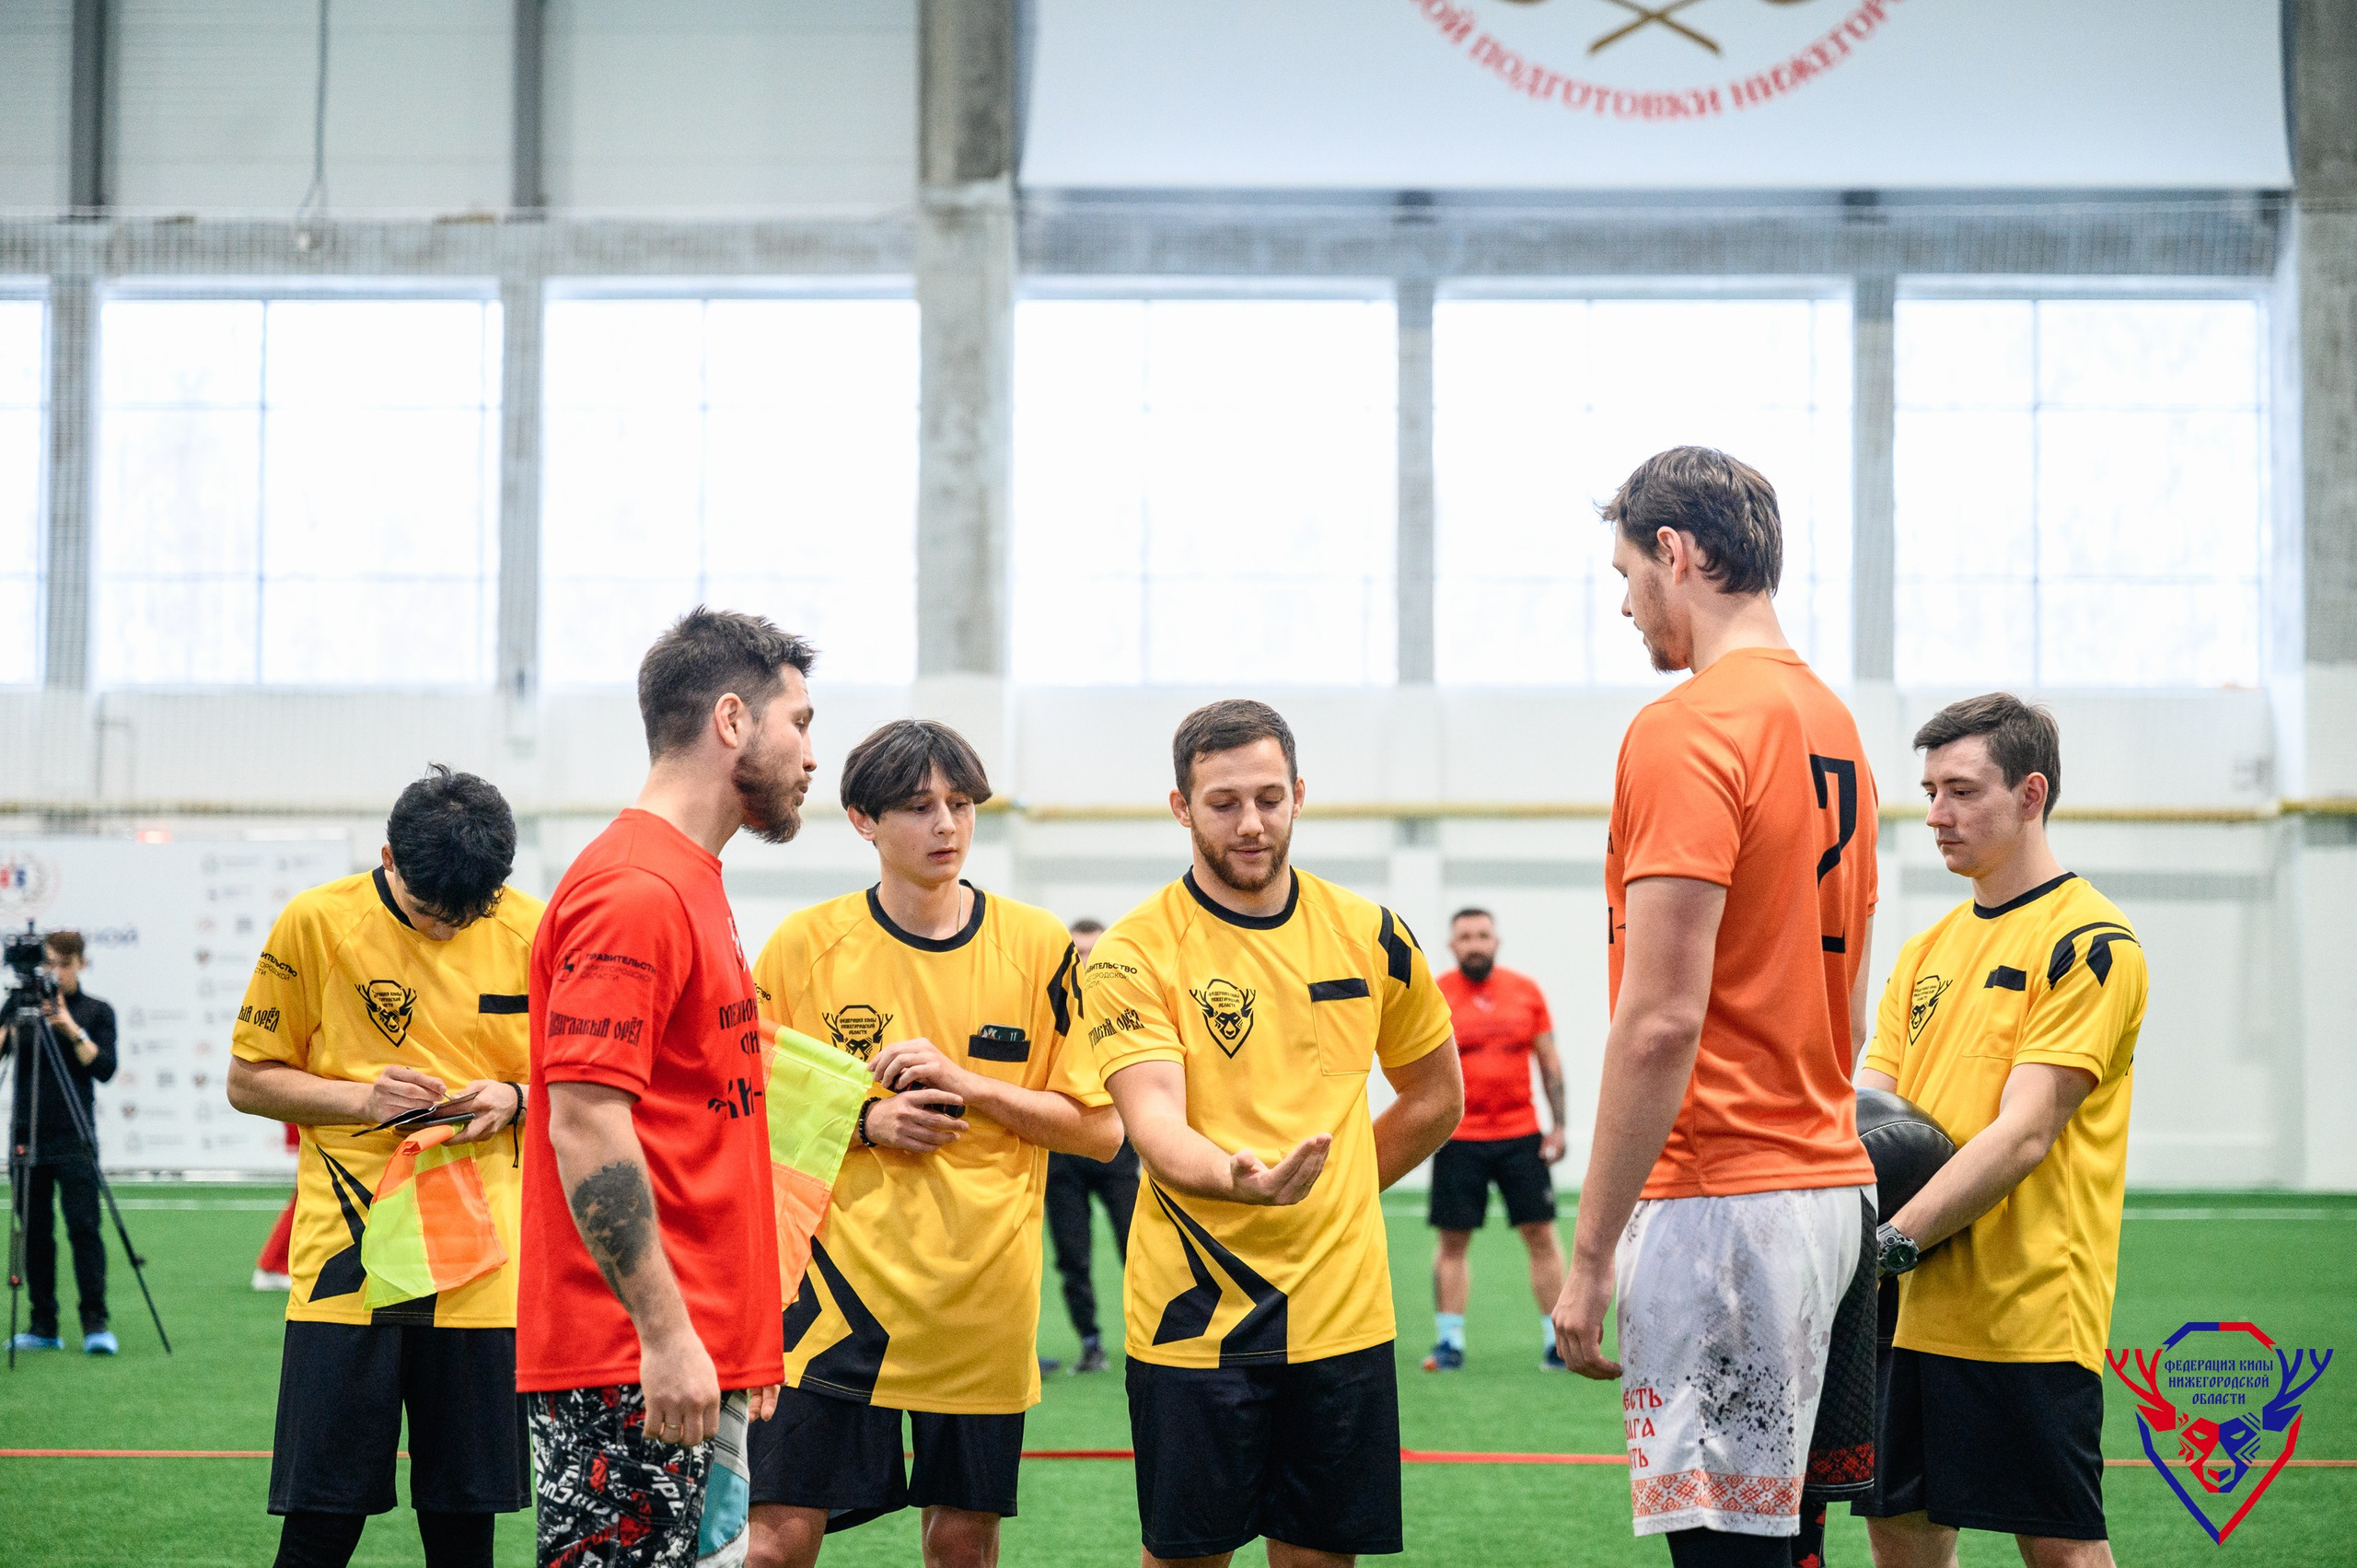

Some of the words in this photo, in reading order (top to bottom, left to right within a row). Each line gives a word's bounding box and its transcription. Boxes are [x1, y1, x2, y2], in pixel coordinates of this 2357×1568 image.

[1809, 753, 1858, 954] 2
[253, 1006, 280, 1033] ОРЁЛ
[613, 1016, 644, 1047] ОРЁЛ
[1116, 1008, 1145, 1030] ОРЁЛ
